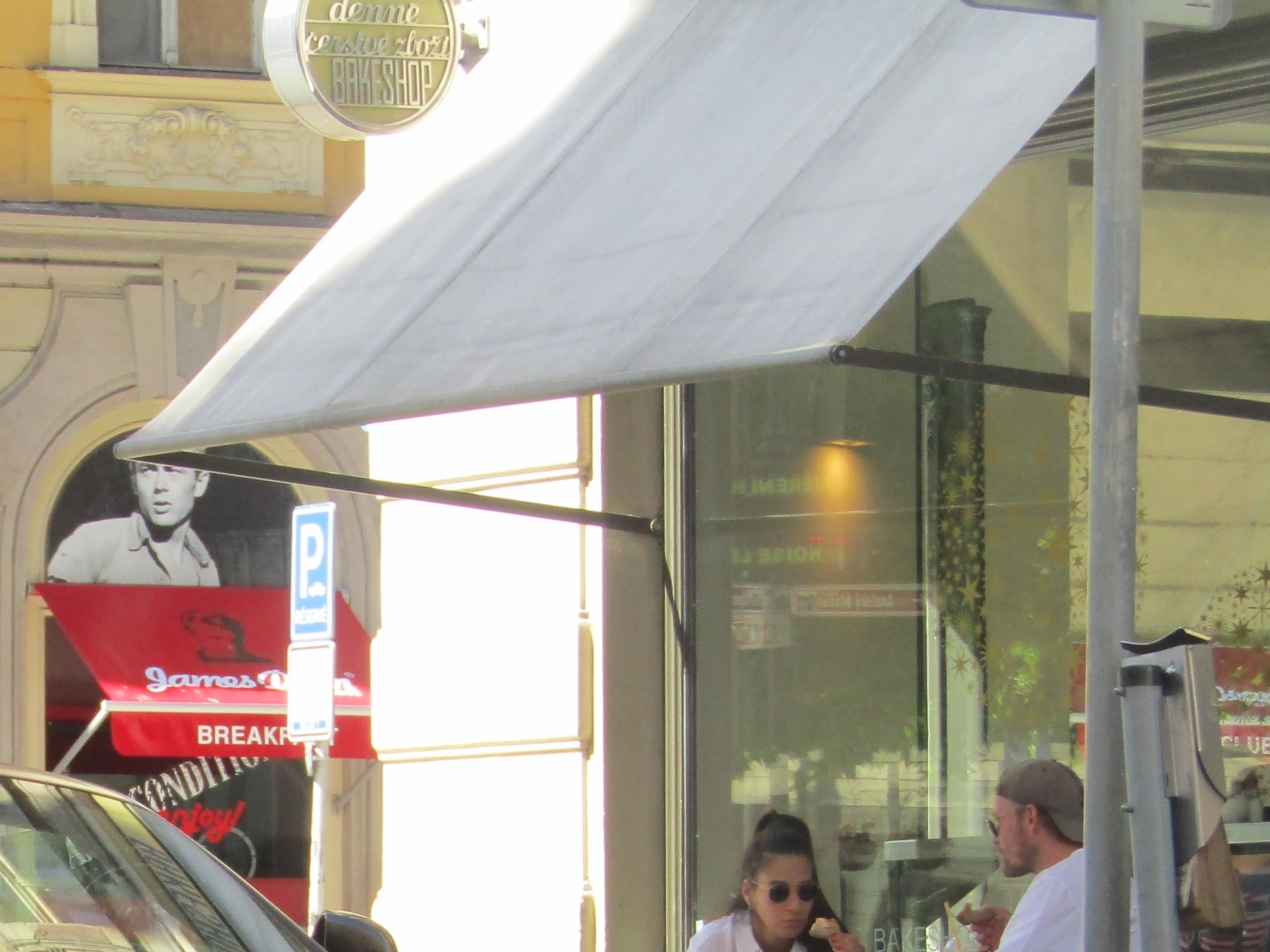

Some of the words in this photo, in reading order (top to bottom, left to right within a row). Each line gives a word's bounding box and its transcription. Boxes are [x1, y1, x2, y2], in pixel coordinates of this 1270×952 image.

[332, 58, 432, 106] BAKESHOP
[299, 522, 325, 599] P
[145, 667, 257, 693] James
[197, 725, 339, 746] BREAKF
